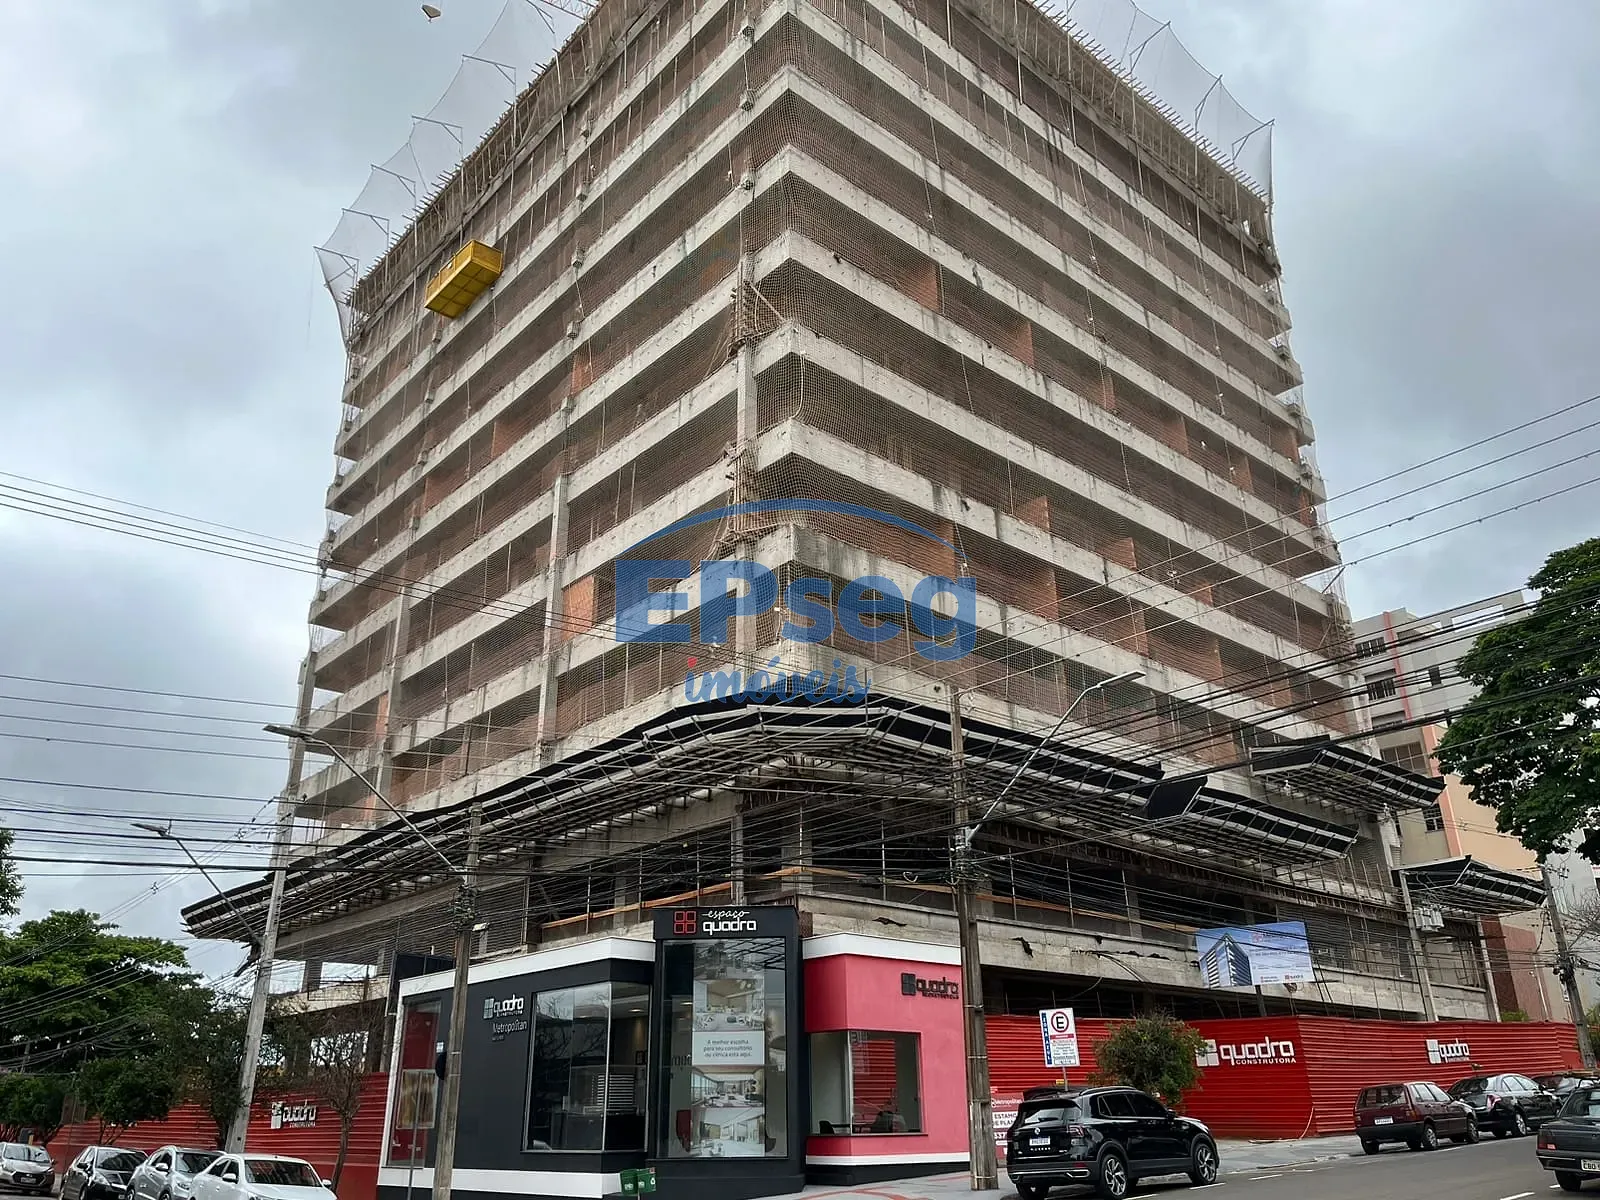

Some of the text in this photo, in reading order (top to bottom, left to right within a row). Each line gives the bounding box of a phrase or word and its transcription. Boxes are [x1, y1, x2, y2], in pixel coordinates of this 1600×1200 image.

[701, 910, 750, 920] espaço
[703, 917, 757, 936] quadra
[916, 977, 959, 996] quadra
[493, 994, 524, 1017] quadra
[1056, 1016, 1065, 1029] E
[1219, 1036, 1295, 1066] quadra
[1439, 1038, 1470, 1063] quadra
[1235, 1057, 1297, 1065] CONSTRUTORA
